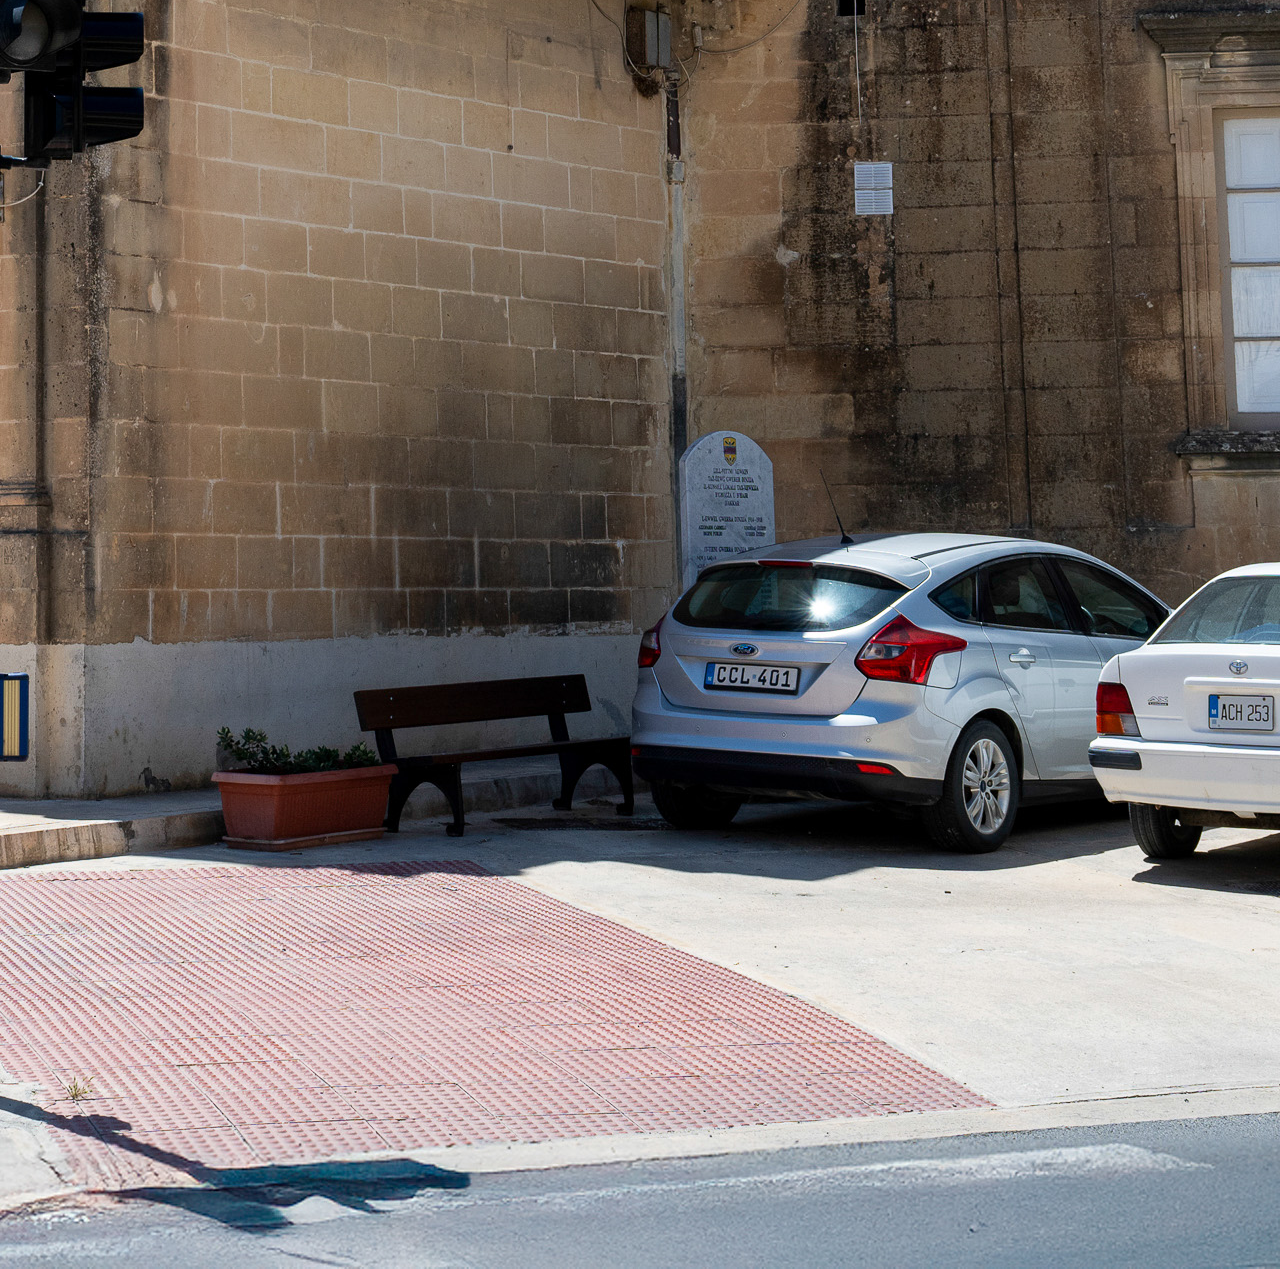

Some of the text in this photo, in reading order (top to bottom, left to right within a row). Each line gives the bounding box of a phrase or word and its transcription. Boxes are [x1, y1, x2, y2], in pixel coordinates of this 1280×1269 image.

[717, 667, 791, 688] CCL 401
[1221, 703, 1270, 722] ACH 253
